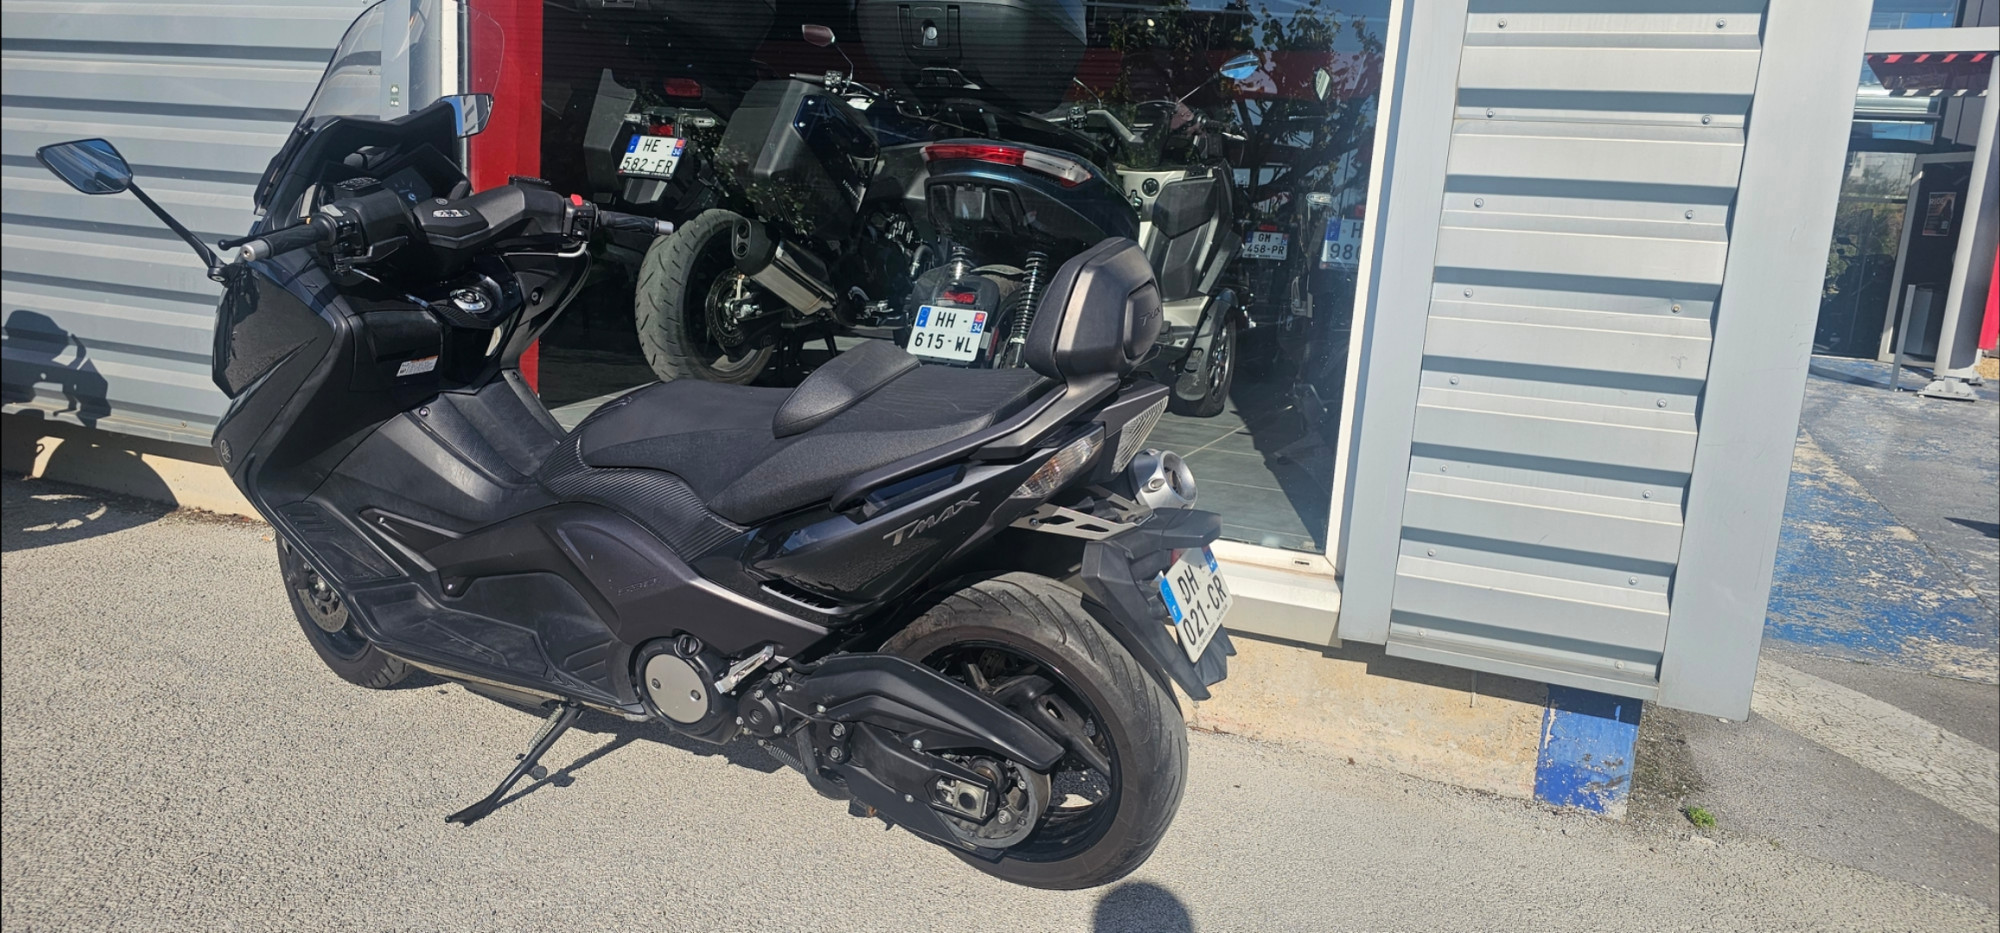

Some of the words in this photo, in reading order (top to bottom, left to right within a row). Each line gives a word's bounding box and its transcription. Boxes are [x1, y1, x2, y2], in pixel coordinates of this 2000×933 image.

[643, 138, 661, 152] HE
[1247, 244, 1284, 255] 458-PR
[935, 311, 957, 328] HH
[914, 332, 972, 353] 615-WL
[1177, 564, 1200, 605] DH
[1183, 574, 1227, 646] 021-CR
